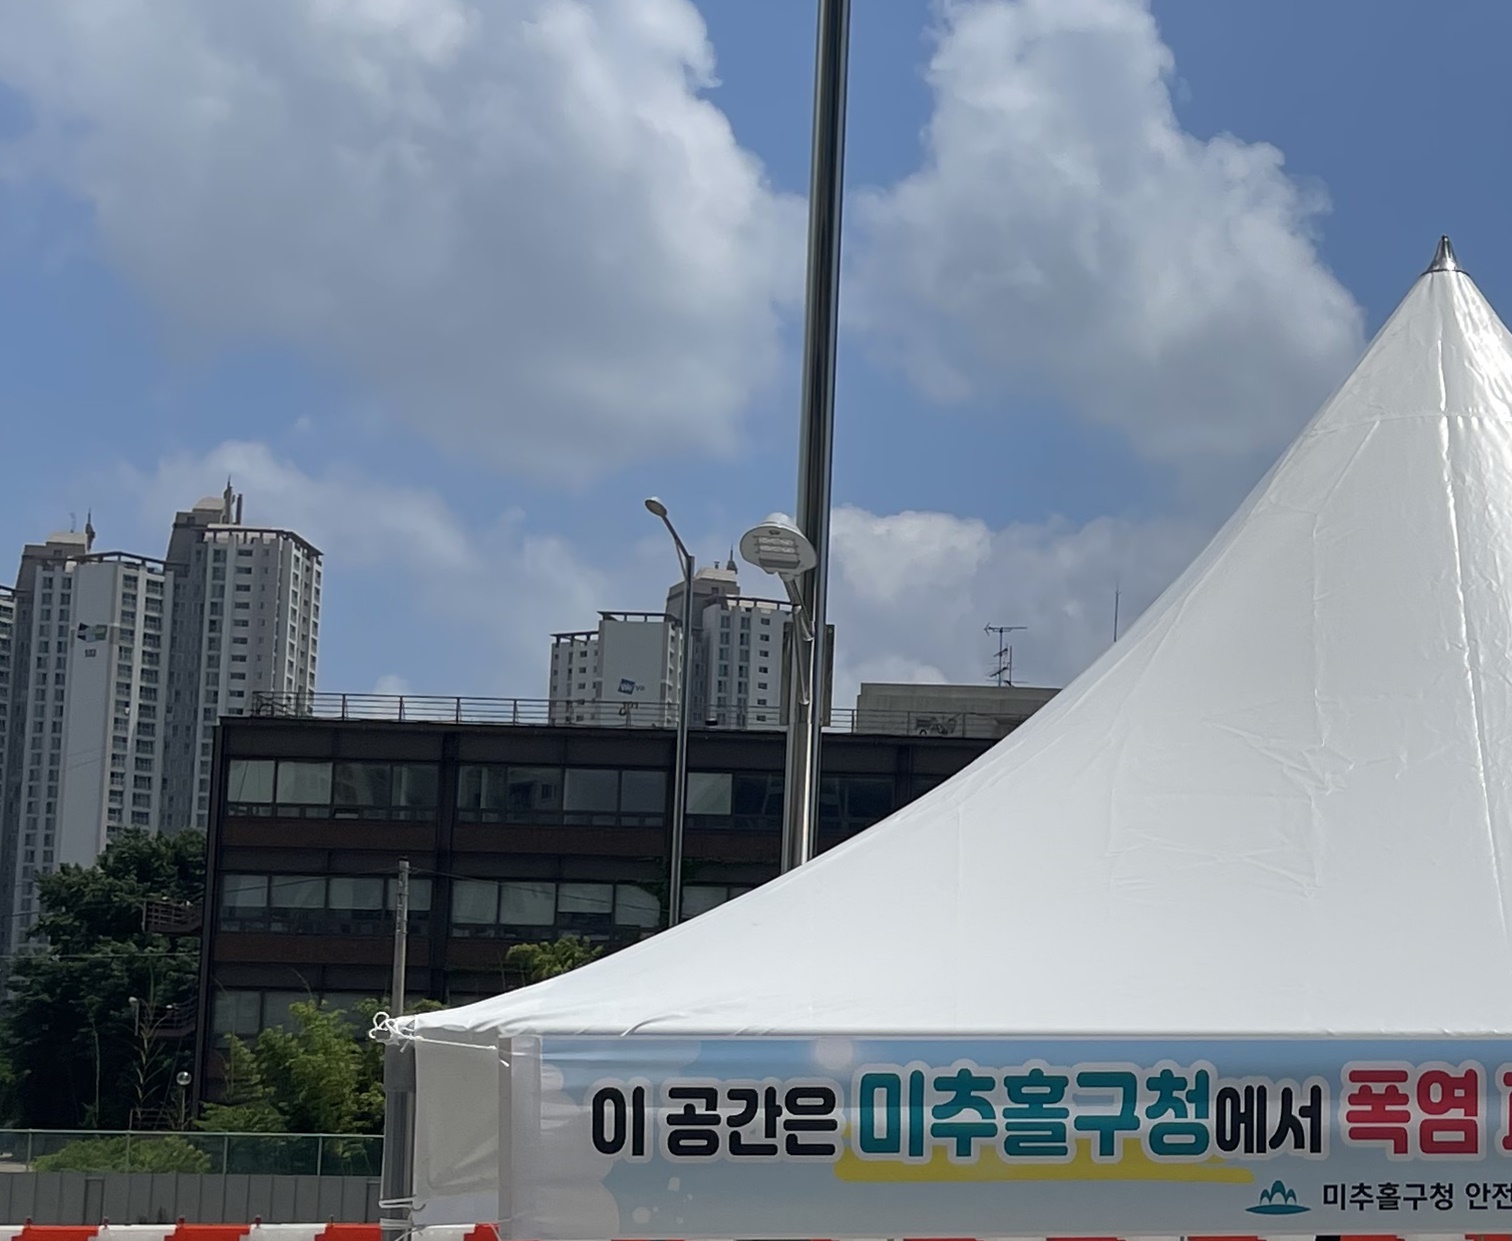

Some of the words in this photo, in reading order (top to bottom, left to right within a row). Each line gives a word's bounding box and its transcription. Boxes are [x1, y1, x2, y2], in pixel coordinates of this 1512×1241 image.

[591, 1085, 644, 1157] 이
[666, 1086, 837, 1157] 공간은
[859, 1068, 1322, 1157] 미추홀구청에서
[1346, 1069, 1479, 1154] 폭염
[1323, 1182, 1455, 1210] 미추홀구청
